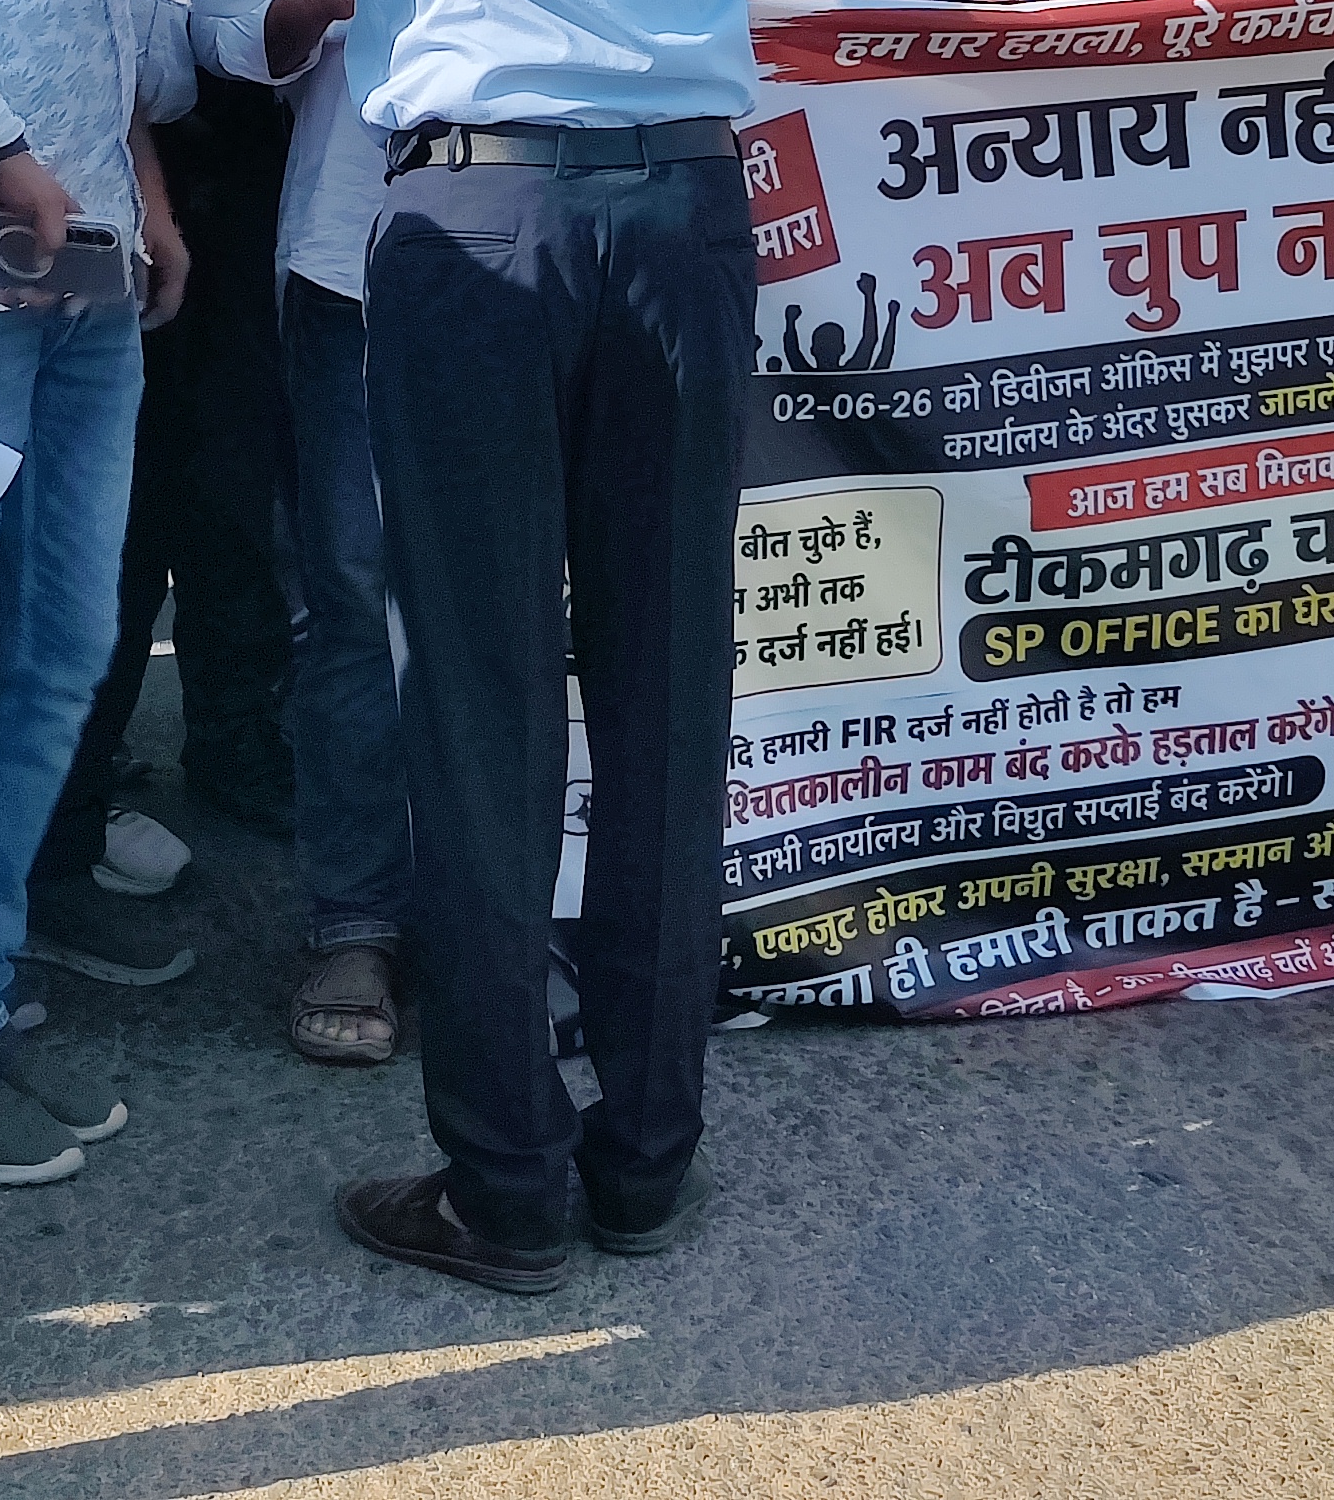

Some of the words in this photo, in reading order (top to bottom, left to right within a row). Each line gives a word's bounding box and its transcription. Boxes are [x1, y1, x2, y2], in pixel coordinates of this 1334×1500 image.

[834, 31, 919, 66] हम
[927, 31, 995, 61] पर
[999, 21, 1143, 58] हमला,
[877, 91, 1197, 200] अन्याय
[910, 230, 1072, 329] अब
[1098, 210, 1247, 331] चुप
[772, 387, 933, 423] 02-06-26
[943, 372, 982, 415] को
[990, 364, 1092, 409] डिवीजन
[1200, 340, 1221, 377] में
[1228, 339, 1309, 384] मुझपर
[943, 416, 1059, 461] कार्यालय
[1067, 407, 1098, 445] के
[1102, 403, 1158, 439] अंदर
[1164, 394, 1251, 440] घुसकर
[1067, 475, 1136, 518] आज
[1144, 469, 1189, 512] हम
[1199, 461, 1248, 498] सब
[738, 524, 791, 560] बीत
[798, 515, 846, 564] चुके
[853, 510, 881, 549] हैं,
[964, 519, 1271, 606] टीकमगढ़
[756, 573, 811, 611] अभी
[819, 574, 865, 605] तक
[757, 623, 807, 666] दर्ज
[815, 618, 868, 660] नहीं
[985, 623, 1044, 667] SP
[1061, 605, 1220, 657] OFFICE
[1235, 602, 1282, 639] का
[730, 735, 754, 769] दि
[761, 720, 831, 764] हमारी
[842, 715, 897, 748] FIR
[907, 707, 954, 742] दर्ज
[961, 700, 1011, 737] नहीं
[1017, 689, 1071, 729] होती
[1078, 685, 1098, 720] है
[1105, 681, 1137, 715] तो
[1142, 684, 1182, 712] हम
[921, 752, 995, 793] काम
[1006, 736, 1052, 782] बंद
[1060, 723, 1142, 774] करके
[1150, 715, 1258, 772] हड़ताल
[723, 849, 743, 887] वं
[749, 833, 802, 881] सभी
[808, 816, 923, 865] कार्यालय
[930, 807, 985, 843] और
[1072, 779, 1162, 826] सप्लाई
[1169, 778, 1211, 811] बंद
[1217, 764, 1294, 804] करेंगे।
[752, 904, 858, 960] एकजुट
[865, 885, 947, 937] होकर
[958, 861, 1055, 910] अपनी
[1066, 856, 1169, 902] सुरक्षा,
[1182, 836, 1295, 877] सम्मान
[882, 936, 936, 999] ही
[942, 907, 1072, 981] हमारी
[1082, 897, 1223, 950] ताकत
[1232, 878, 1267, 927] है
[1066, 978, 1093, 1011] है
[1270, 937, 1318, 975] चलें
